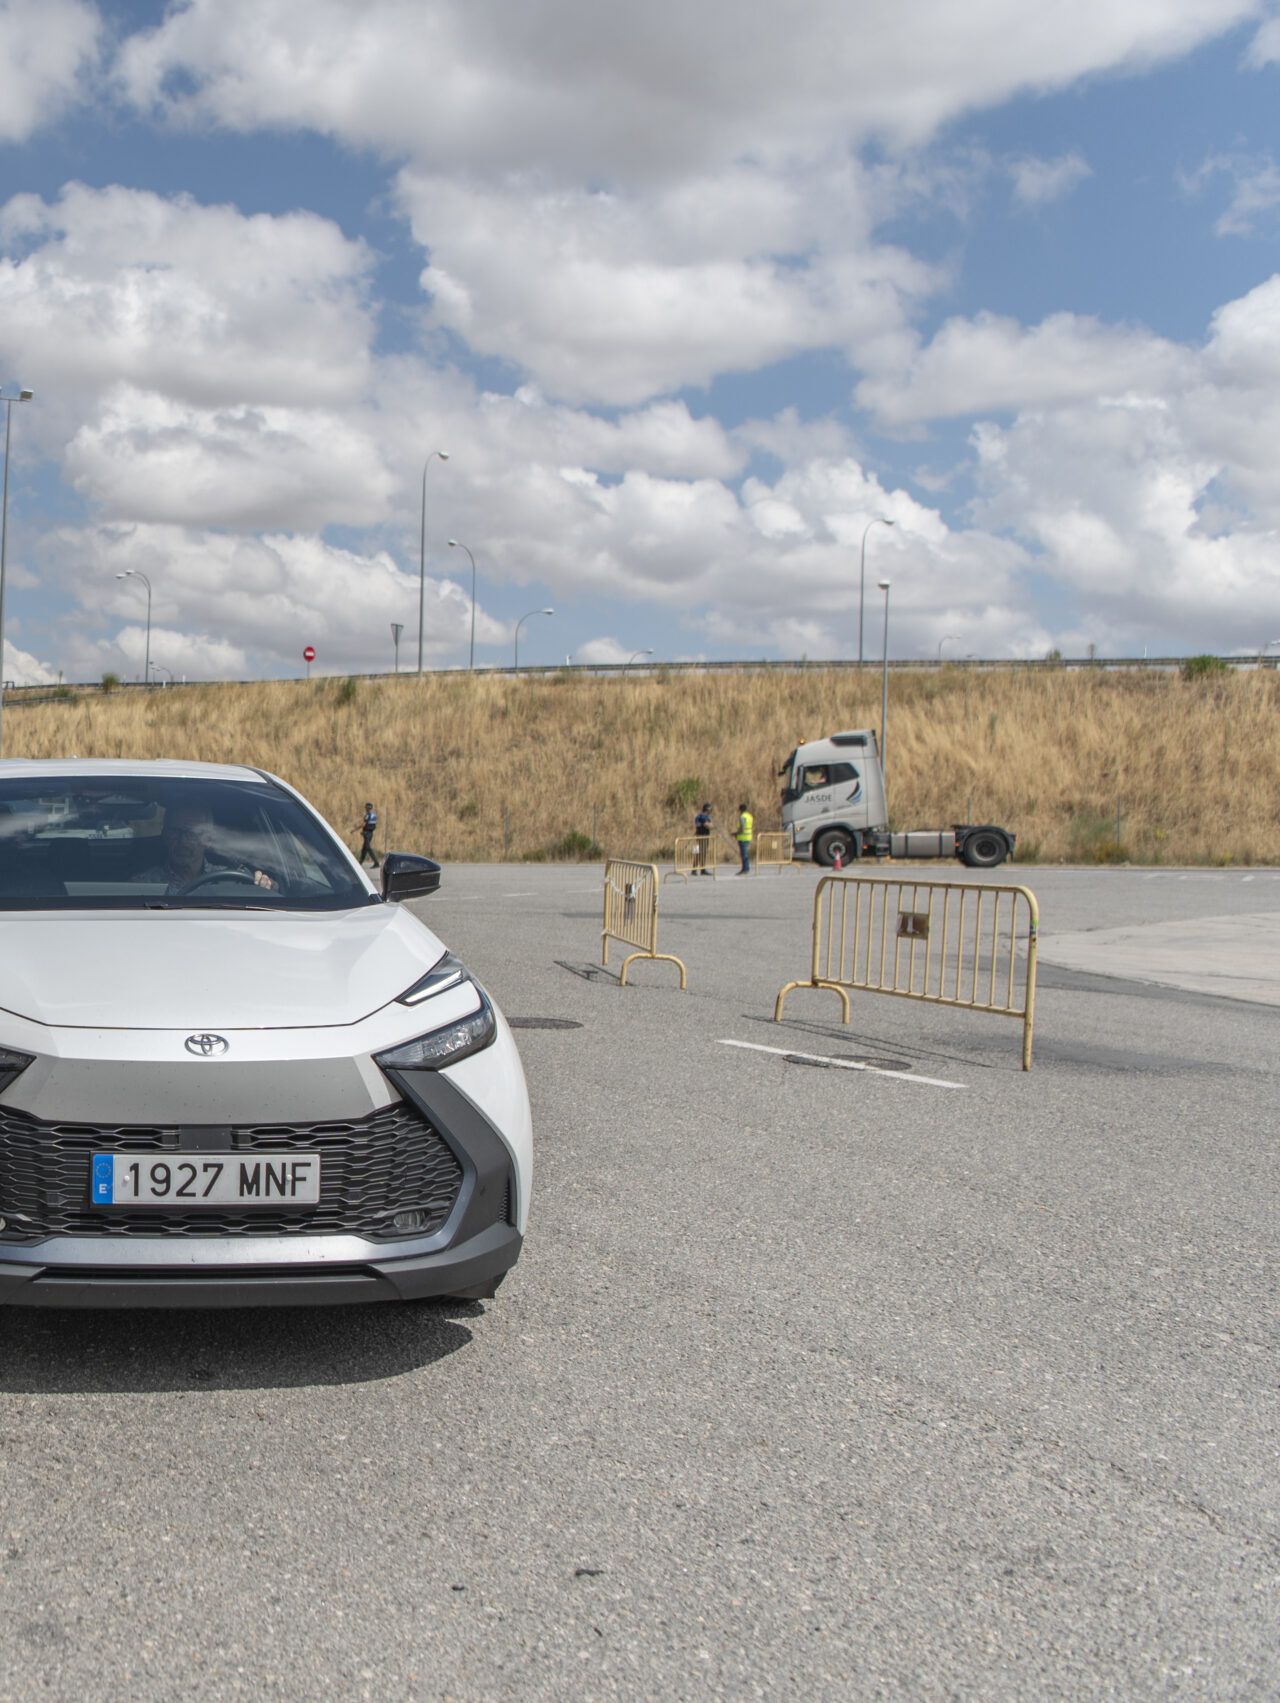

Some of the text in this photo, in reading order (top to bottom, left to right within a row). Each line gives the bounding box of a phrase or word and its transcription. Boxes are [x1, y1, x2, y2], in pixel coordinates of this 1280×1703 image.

[99, 1183, 108, 1194] E
[129, 1162, 312, 1198] 1927 MNF
